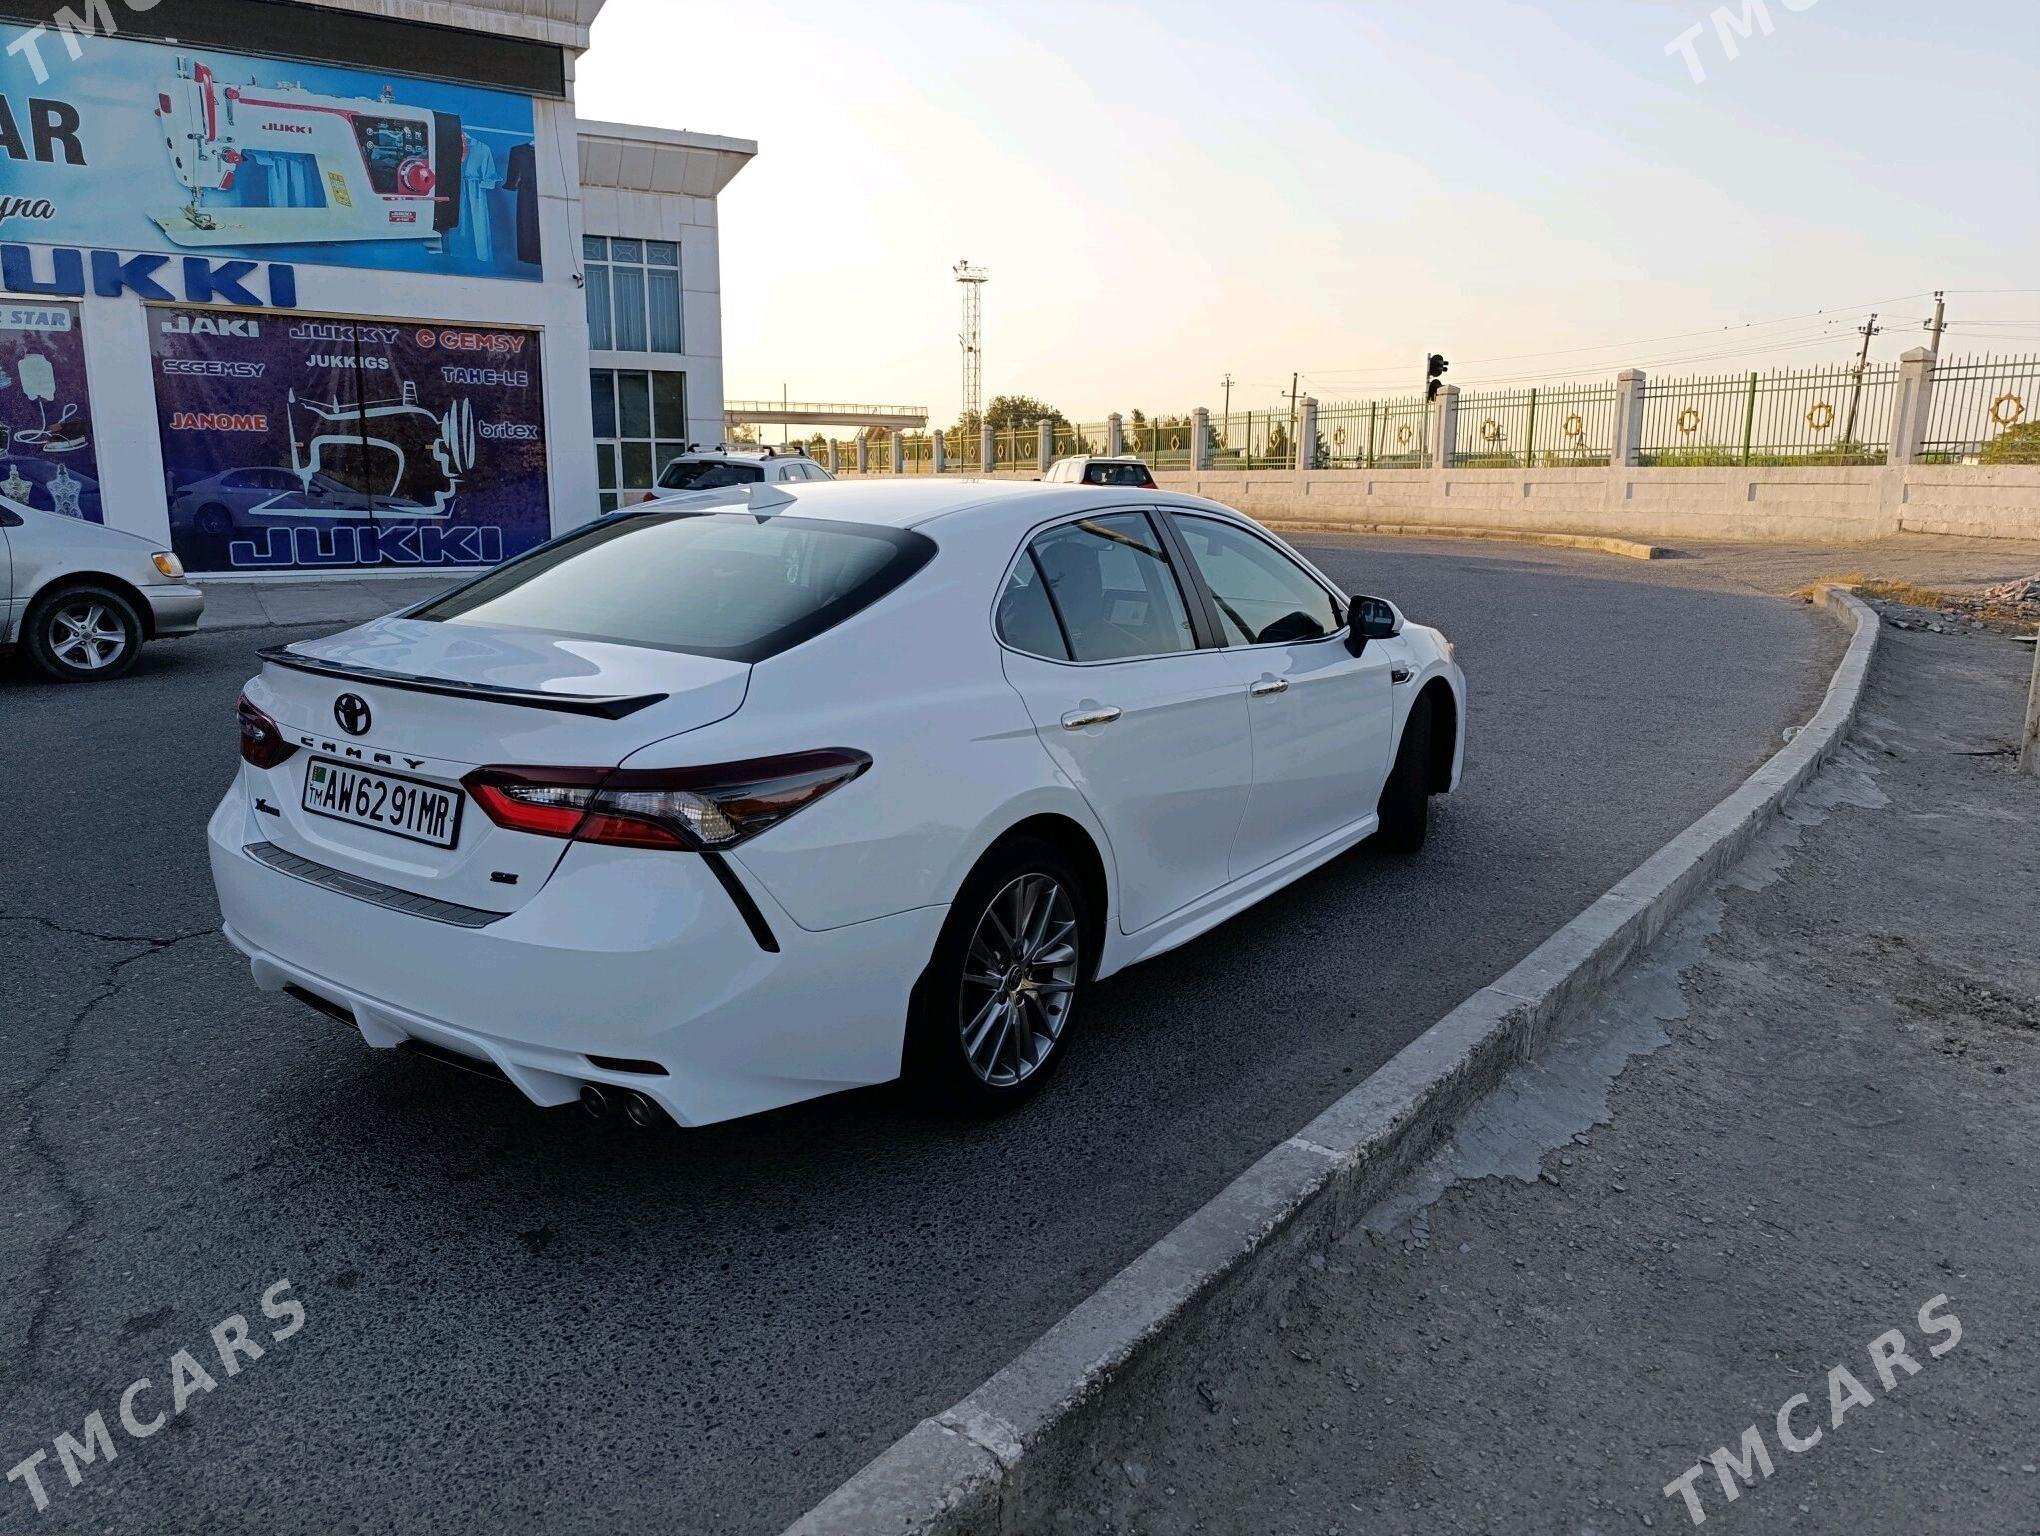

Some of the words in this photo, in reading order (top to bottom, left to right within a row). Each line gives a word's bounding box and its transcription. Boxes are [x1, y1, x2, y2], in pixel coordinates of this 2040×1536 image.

[262, 123, 312, 134] JUKKI
[11, 311, 66, 326] STAR
[161, 316, 260, 338] JAKI
[289, 323, 400, 344] JUKKY
[439, 332, 525, 353] GEMSY
[306, 354, 389, 370] JUKKIGS
[170, 412, 269, 432] JANOME
[479, 420, 538, 440] britex
[229, 526, 502, 566] JUKKI
[301, 736, 425, 770] CAMRY
[309, 785, 324, 806] TM
